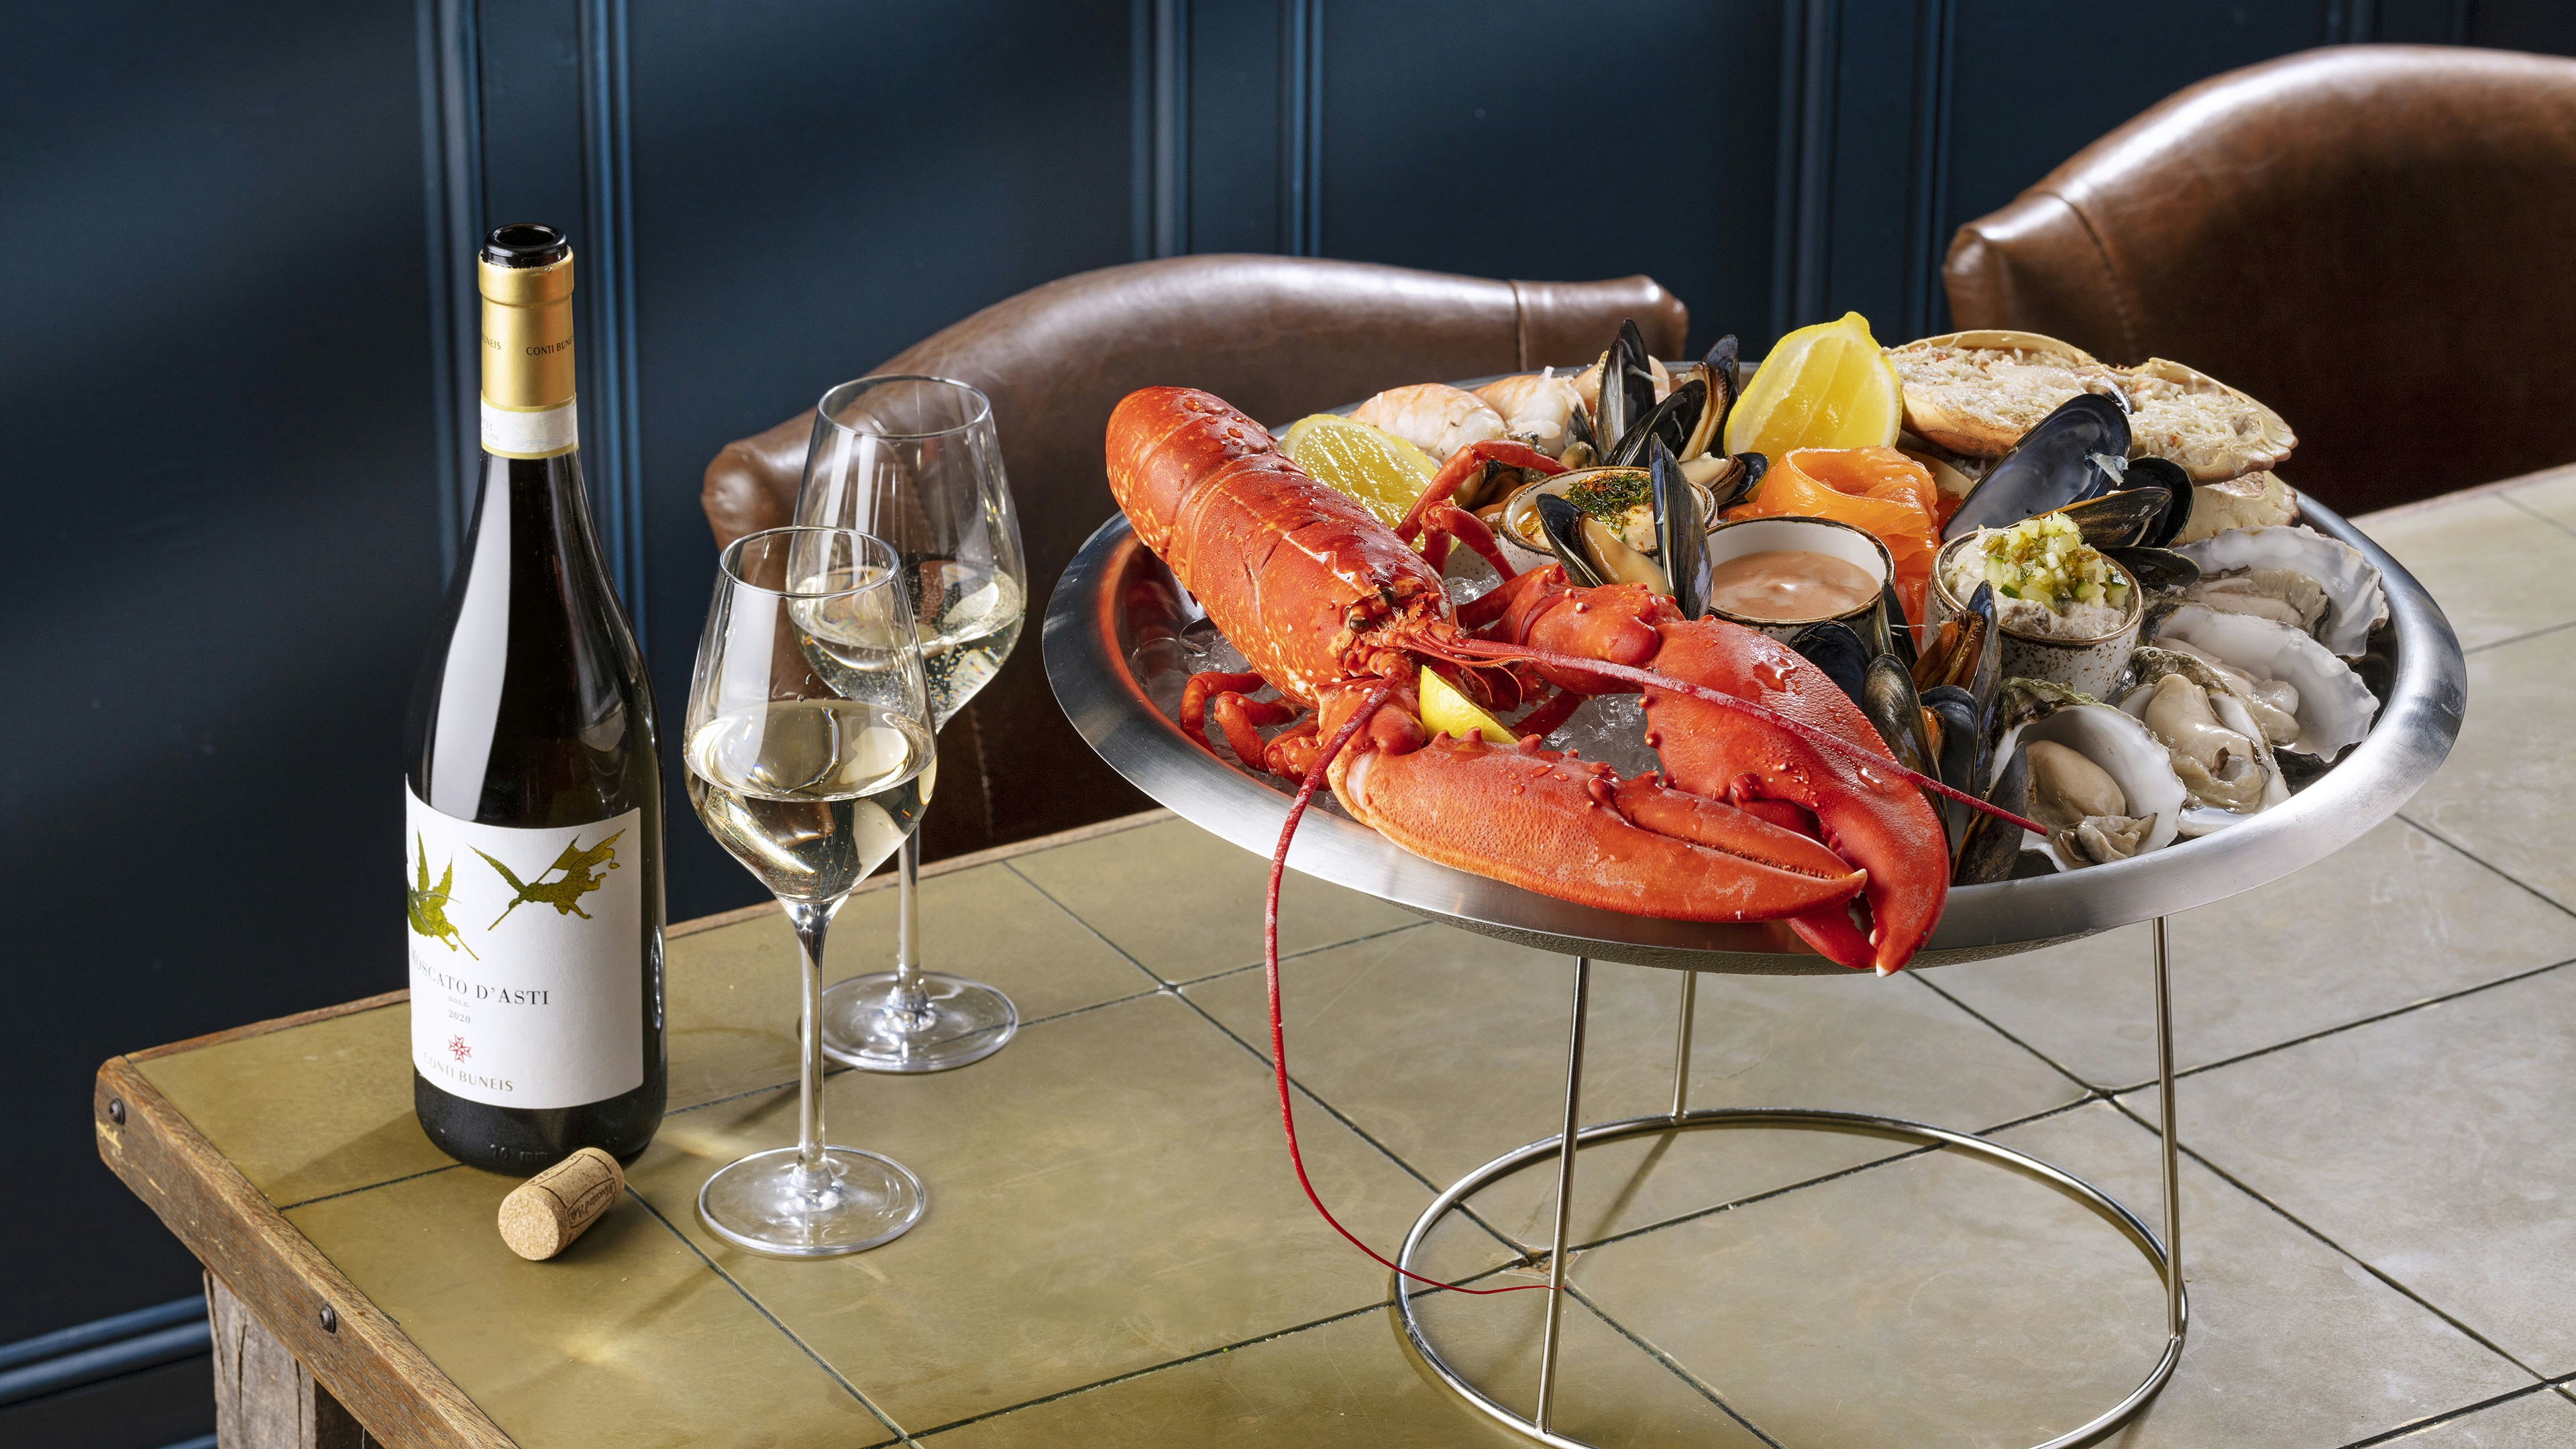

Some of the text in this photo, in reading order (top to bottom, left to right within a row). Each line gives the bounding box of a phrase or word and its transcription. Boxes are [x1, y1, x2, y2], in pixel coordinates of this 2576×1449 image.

[526, 345, 554, 356] CONTI
[411, 946, 549, 1005] MOSCATO D'ASTI
[448, 1009, 471, 1024] 2020
[424, 1052, 513, 1092] CONTI BUNEIS
